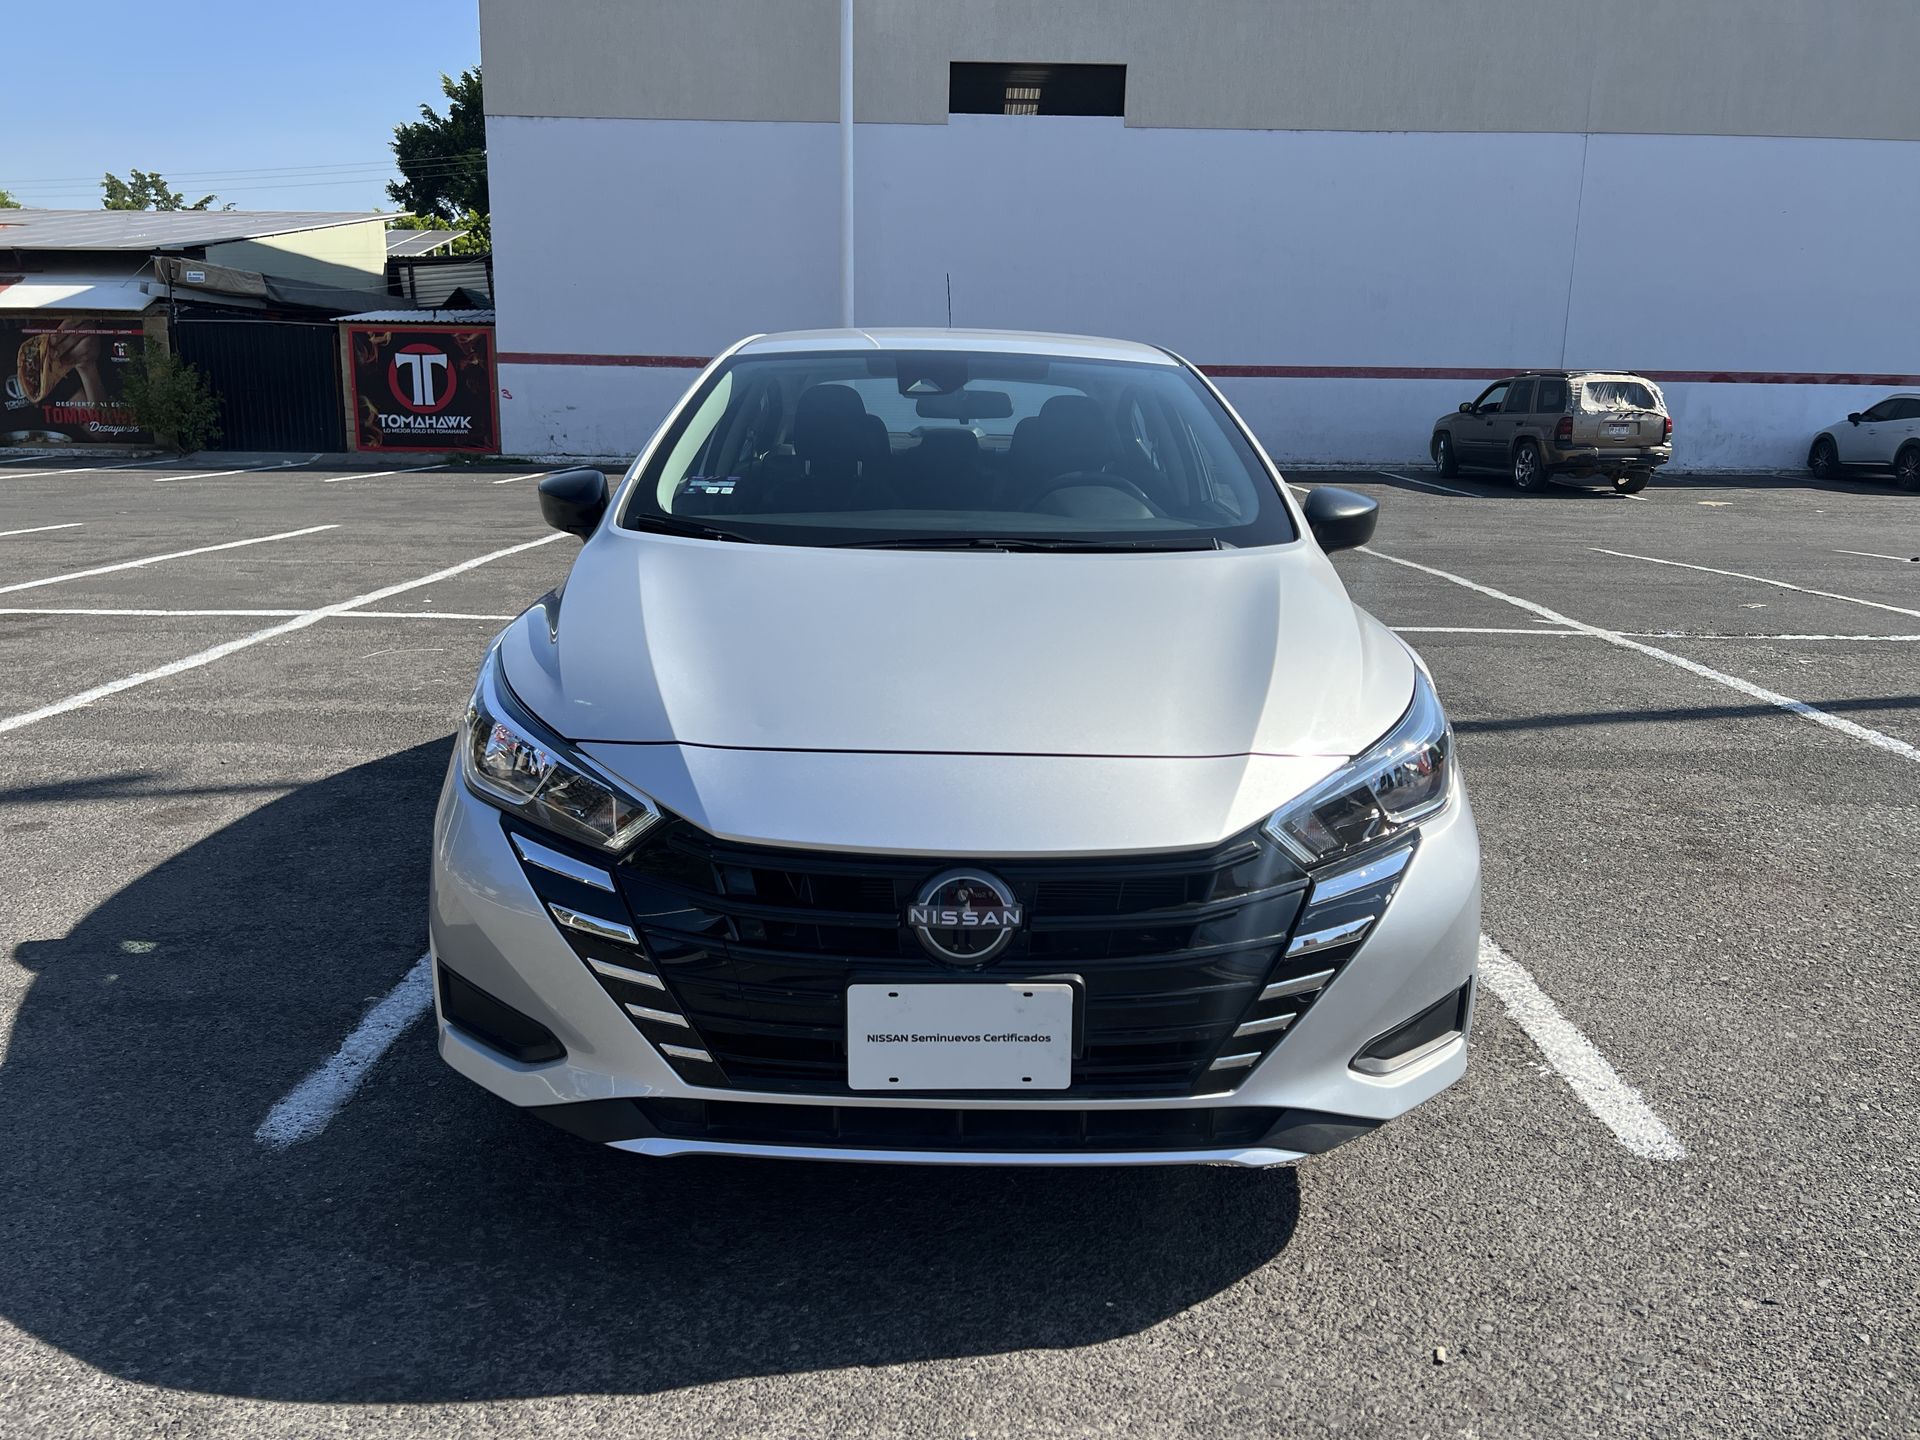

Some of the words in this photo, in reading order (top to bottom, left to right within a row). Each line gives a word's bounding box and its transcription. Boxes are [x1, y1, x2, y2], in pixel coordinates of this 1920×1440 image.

[378, 414, 472, 429] TOMAHAWK
[910, 908, 1020, 926] NISSAN
[866, 1034, 909, 1043] NISSAN
[911, 1033, 981, 1043] Seminuevos
[983, 1033, 1052, 1043] Certificados
